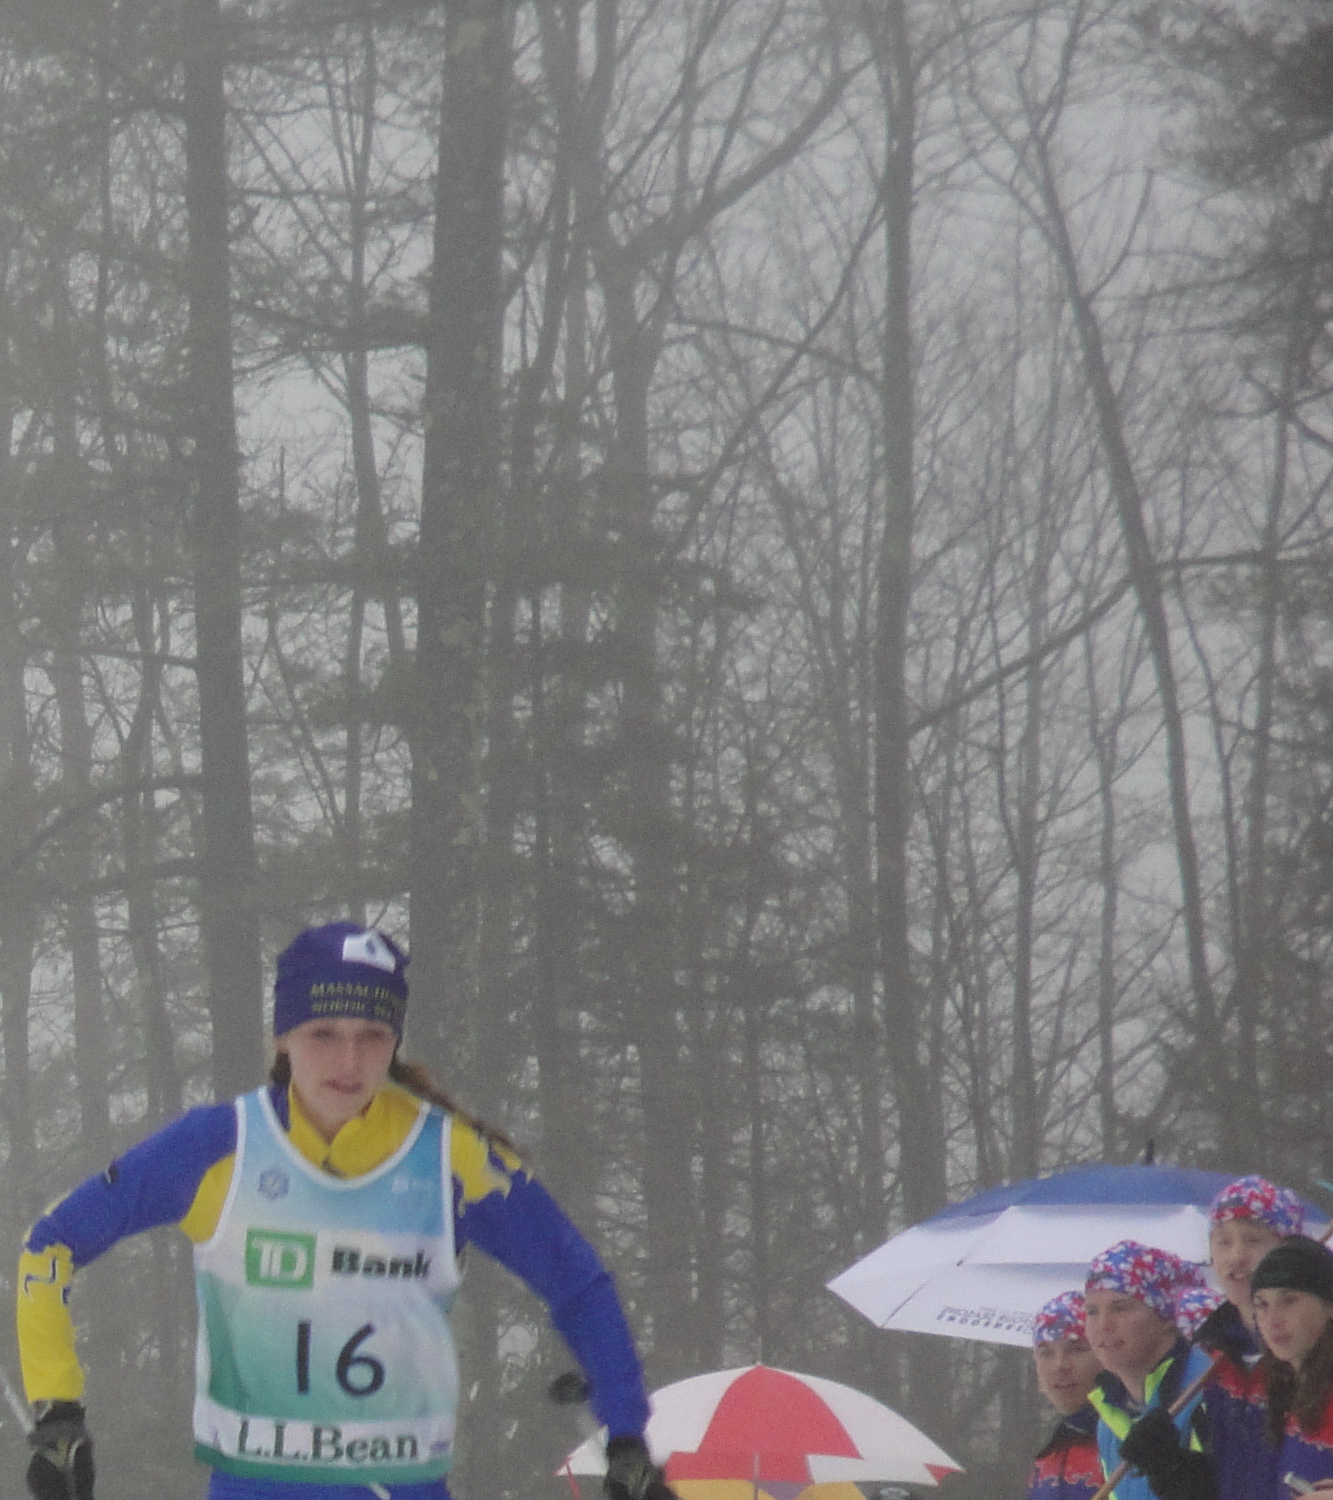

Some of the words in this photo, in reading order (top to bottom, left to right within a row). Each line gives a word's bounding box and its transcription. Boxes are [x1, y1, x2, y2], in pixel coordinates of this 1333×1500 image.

[249, 1234, 312, 1284] TD
[332, 1245, 432, 1281] Bank
[296, 1320, 386, 1397] 16
[238, 1418, 419, 1463] L.L.Bean
